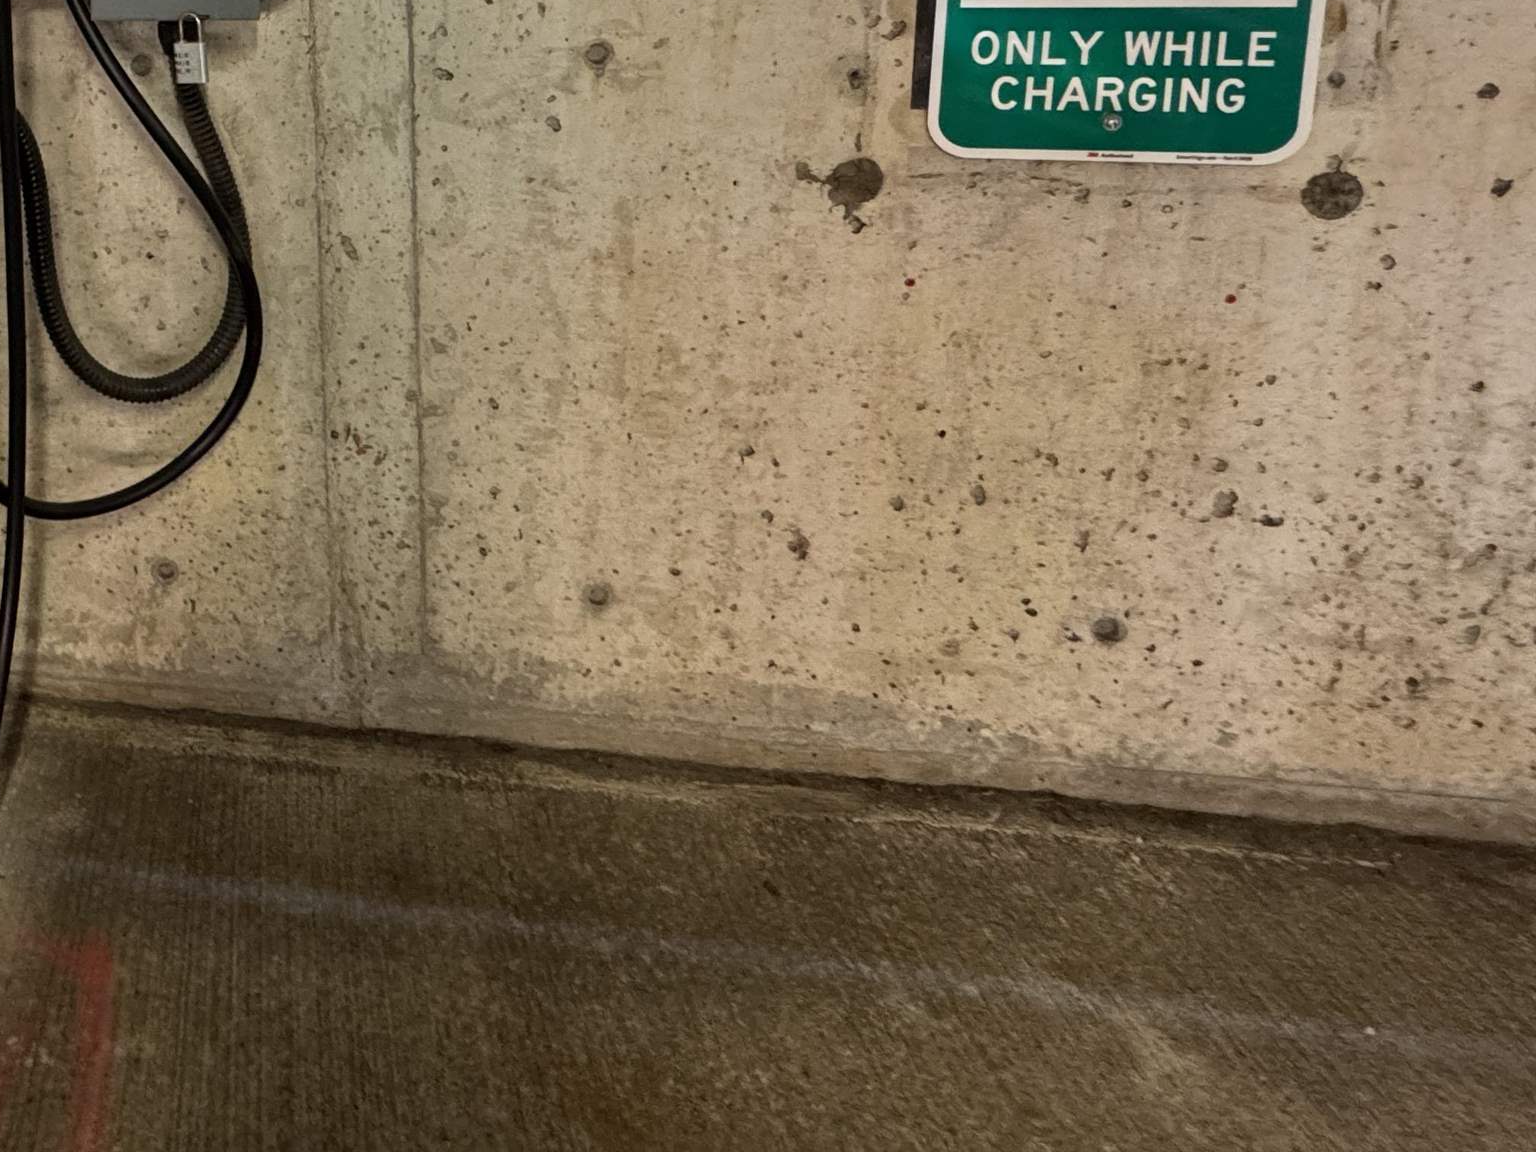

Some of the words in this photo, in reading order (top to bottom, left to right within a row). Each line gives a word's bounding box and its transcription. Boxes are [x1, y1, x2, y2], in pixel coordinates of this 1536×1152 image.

[971, 30, 1105, 67] ONLY
[1125, 30, 1278, 67] WHILE
[991, 76, 1246, 113] CHARGING
